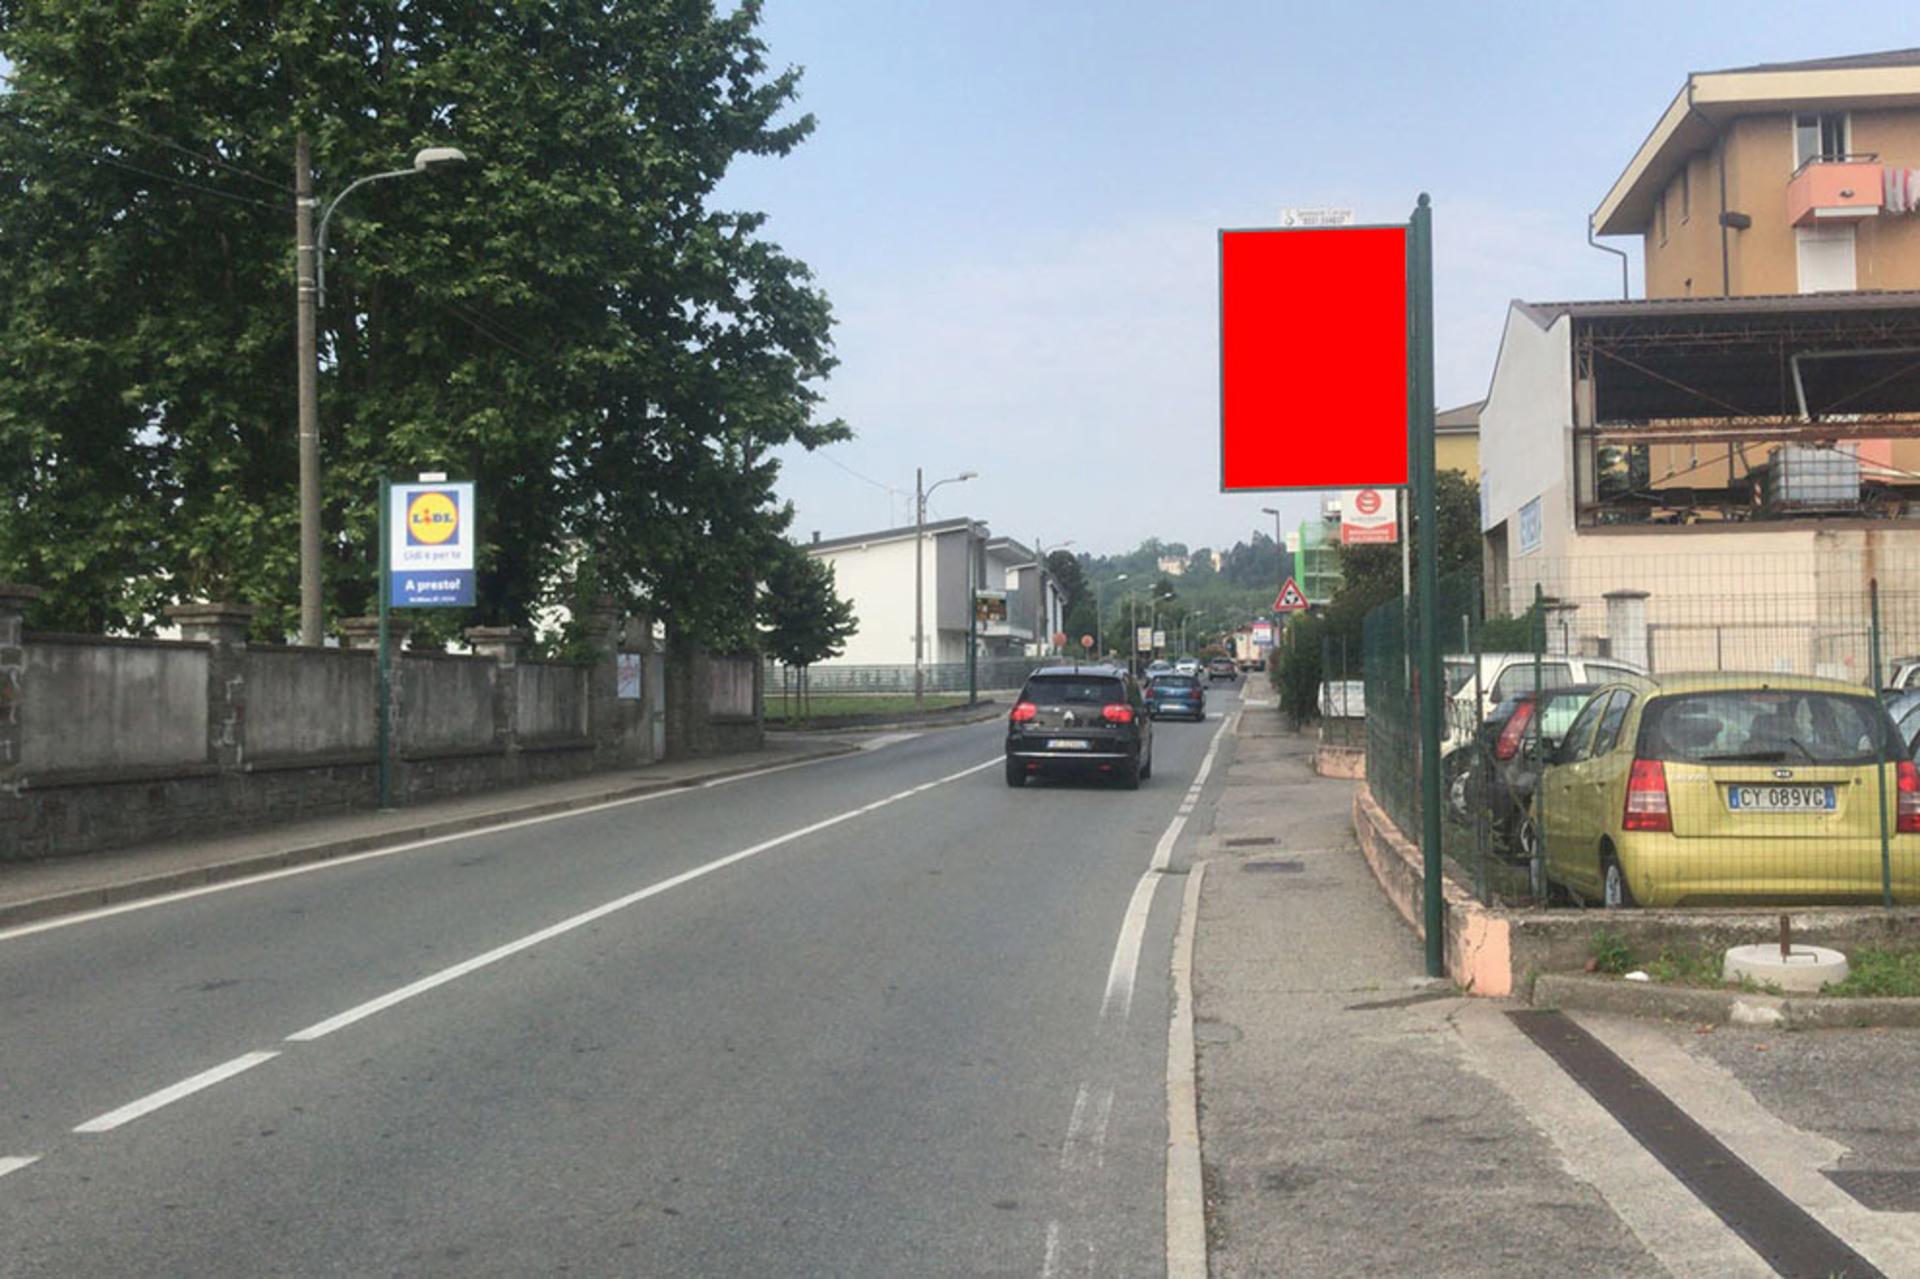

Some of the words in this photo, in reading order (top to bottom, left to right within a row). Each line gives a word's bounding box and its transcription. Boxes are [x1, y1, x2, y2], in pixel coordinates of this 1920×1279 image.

[405, 579, 415, 591] A
[1741, 788, 1761, 806] CY
[1769, 788, 1824, 806] 089VG
